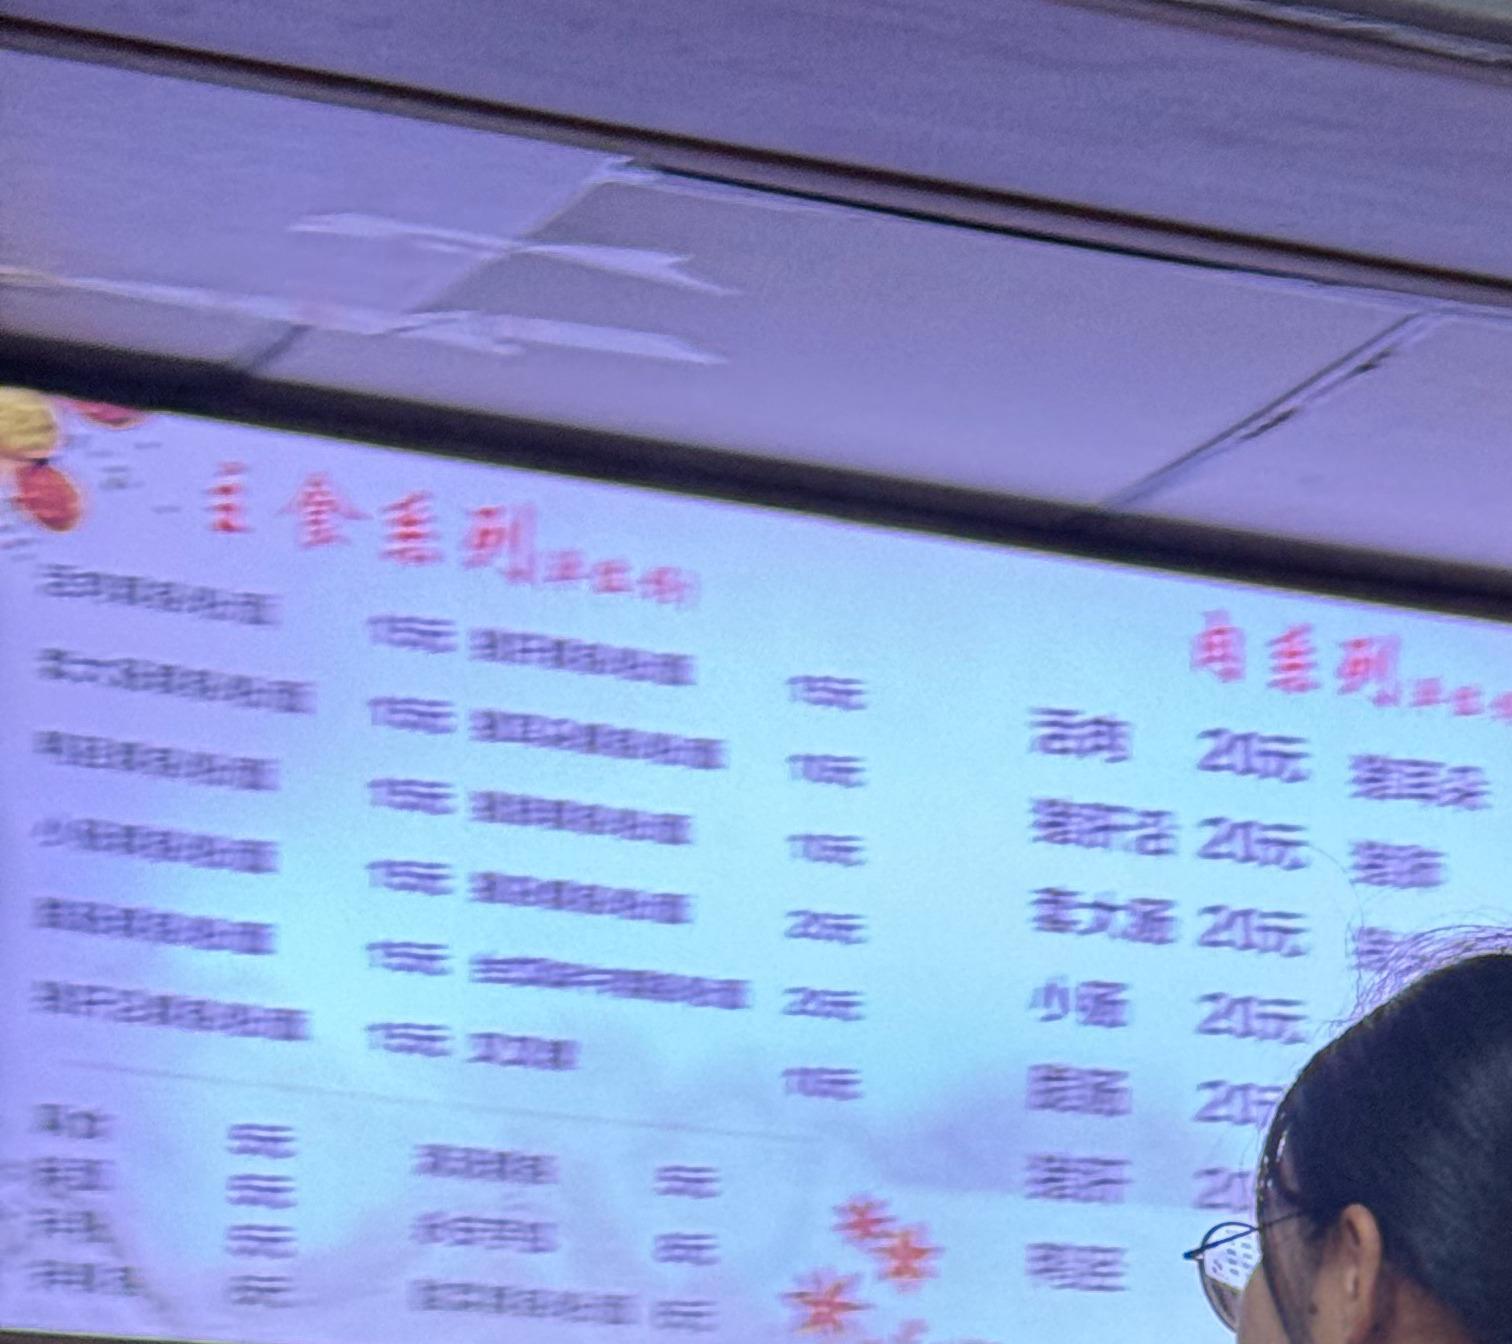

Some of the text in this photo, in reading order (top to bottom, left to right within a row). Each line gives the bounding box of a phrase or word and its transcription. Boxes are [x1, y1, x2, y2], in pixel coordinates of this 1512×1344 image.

[1196, 727, 1312, 783] 20元
[1196, 816, 1312, 871] 20元
[1196, 904, 1312, 957] 20元
